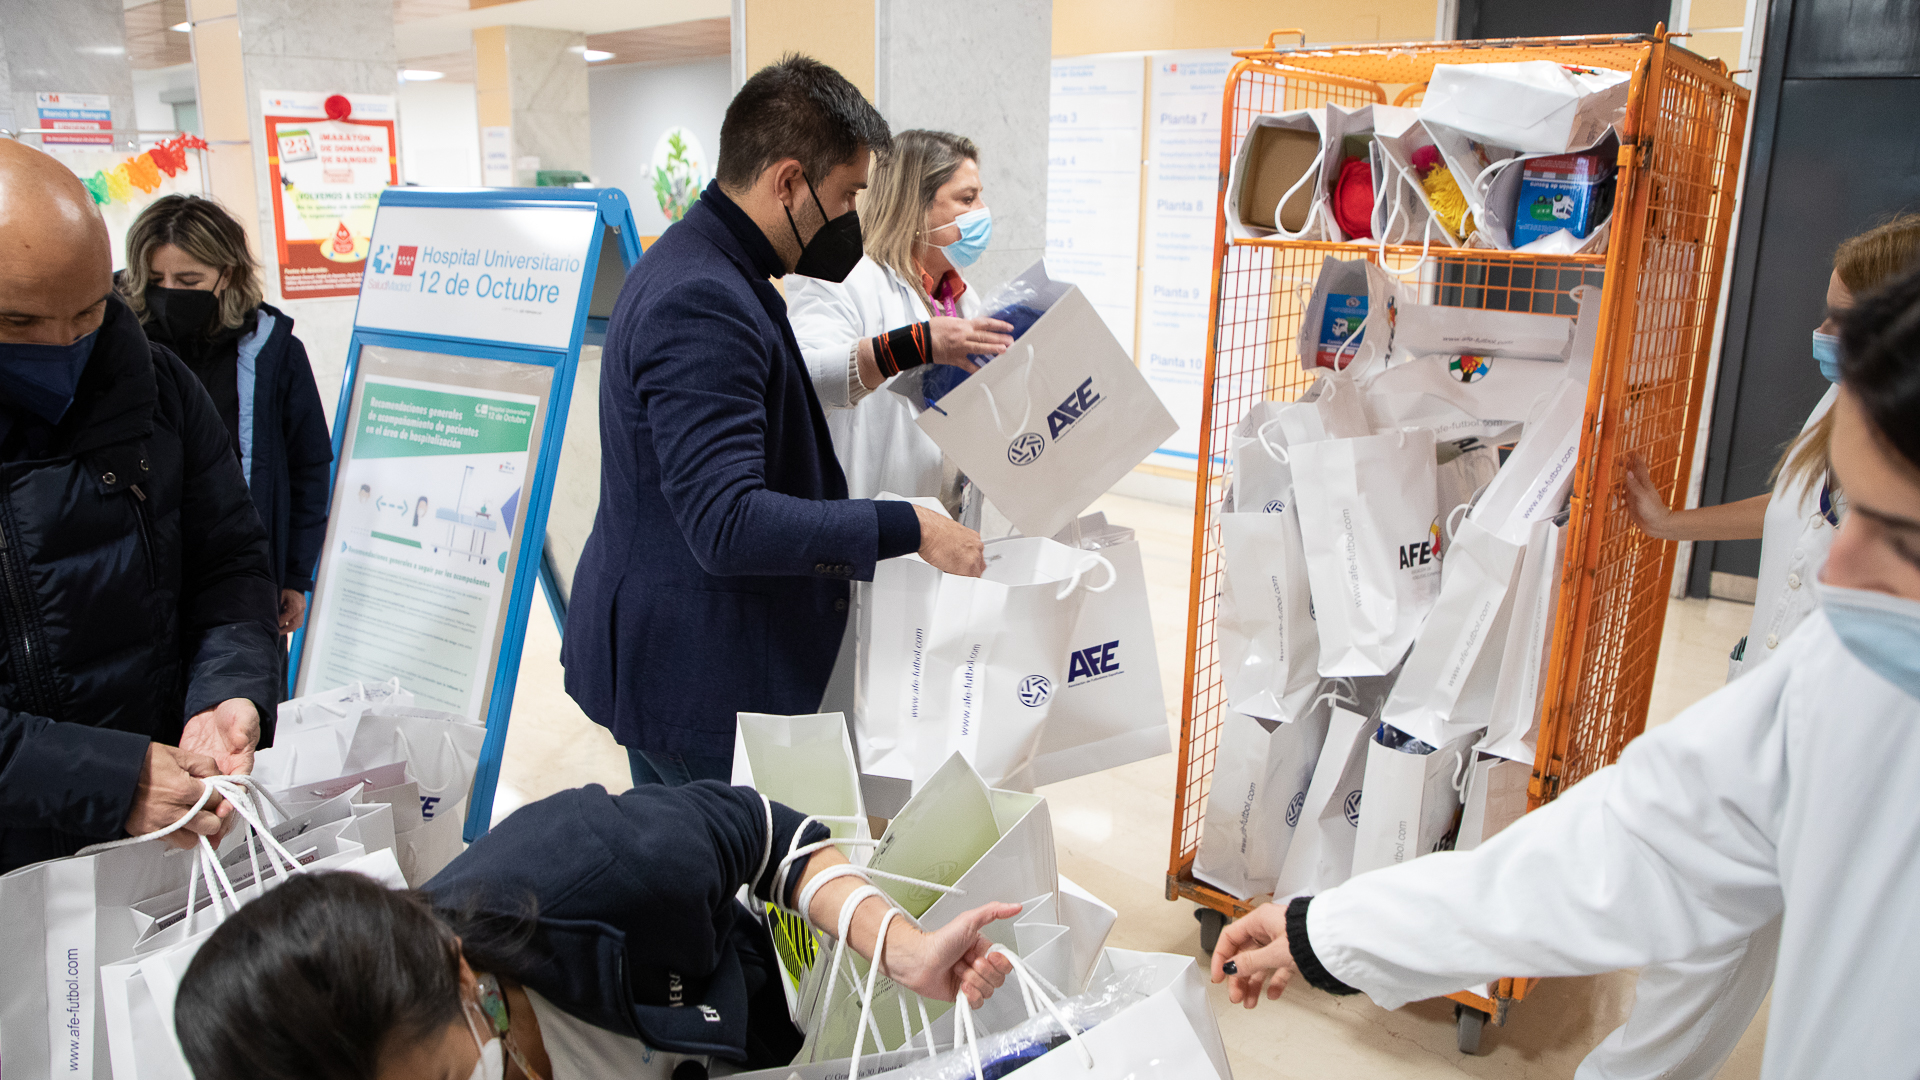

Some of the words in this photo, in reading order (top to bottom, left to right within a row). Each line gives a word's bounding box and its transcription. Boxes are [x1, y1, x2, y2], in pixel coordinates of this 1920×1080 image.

[1160, 112, 1198, 125] Planta
[1201, 112, 1208, 124] 7
[284, 136, 311, 155] 23
[354, 192, 380, 200] ESCEN
[1156, 198, 1193, 212] Planta
[1196, 200, 1203, 212] 8
[422, 246, 481, 268] Hospital
[484, 248, 580, 273] Universitario
[367, 278, 411, 292] SaludMadrid
[419, 270, 440, 294] 12
[445, 272, 469, 297] de
[476, 273, 560, 304] Octubre
[1153, 284, 1190, 298] Planta
[1193, 287, 1200, 299] 9
[1150, 353, 1185, 368] Planta
[1189, 358, 1202, 370] 10
[370, 396, 428, 415] Recomendaciones
[428, 407, 463, 421] generales
[487, 412, 495, 420] 12
[495, 412, 503, 421] de
[503, 413, 527, 425] Octubre
[1047, 375, 1100, 441] AFE
[365, 426, 374, 434] en
[375, 425, 383, 435] el
[383, 425, 398, 439] área
[399, 428, 409, 440] de
[409, 430, 462, 449] hospitalización
[367, 410, 376, 421] de
[377, 412, 434, 430] acompañamiento
[435, 420, 444, 432] de
[445, 423, 479, 438] pacientes
[1435, 419, 1503, 434] afe-futbol.com
[1523, 446, 1576, 519] www.afe-futbol.com
[1342, 508, 1363, 608] www.afe-futbol.com
[1399, 541, 1432, 570] AFE
[1448, 600, 1492, 688] www.afe-futbol.com
[911, 628, 923, 718] www.afe-futbol.com
[1067, 639, 1120, 684] AFE
[961, 643, 981, 736] www.afe-futbol.com
[66, 948, 80, 1072] www.afe-futbol.com
